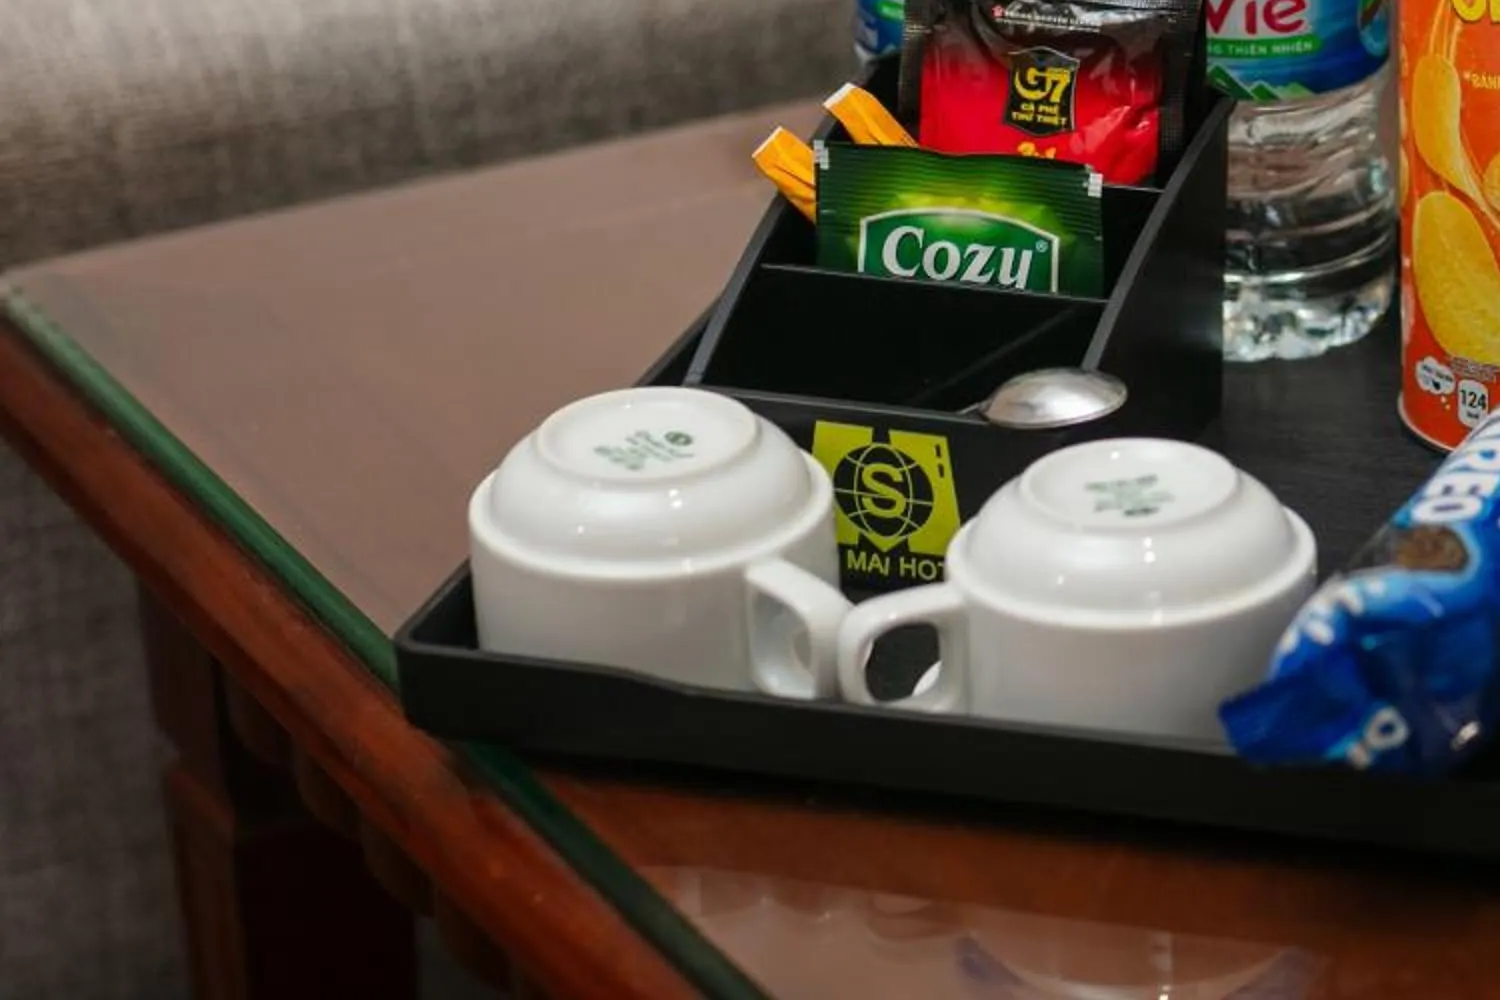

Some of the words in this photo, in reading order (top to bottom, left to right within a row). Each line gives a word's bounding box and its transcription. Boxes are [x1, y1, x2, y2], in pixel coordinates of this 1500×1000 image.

[1014, 66, 1071, 103] G7
[1460, 389, 1487, 411] 124
[847, 549, 890, 575] MAI
[899, 555, 946, 581] HO
